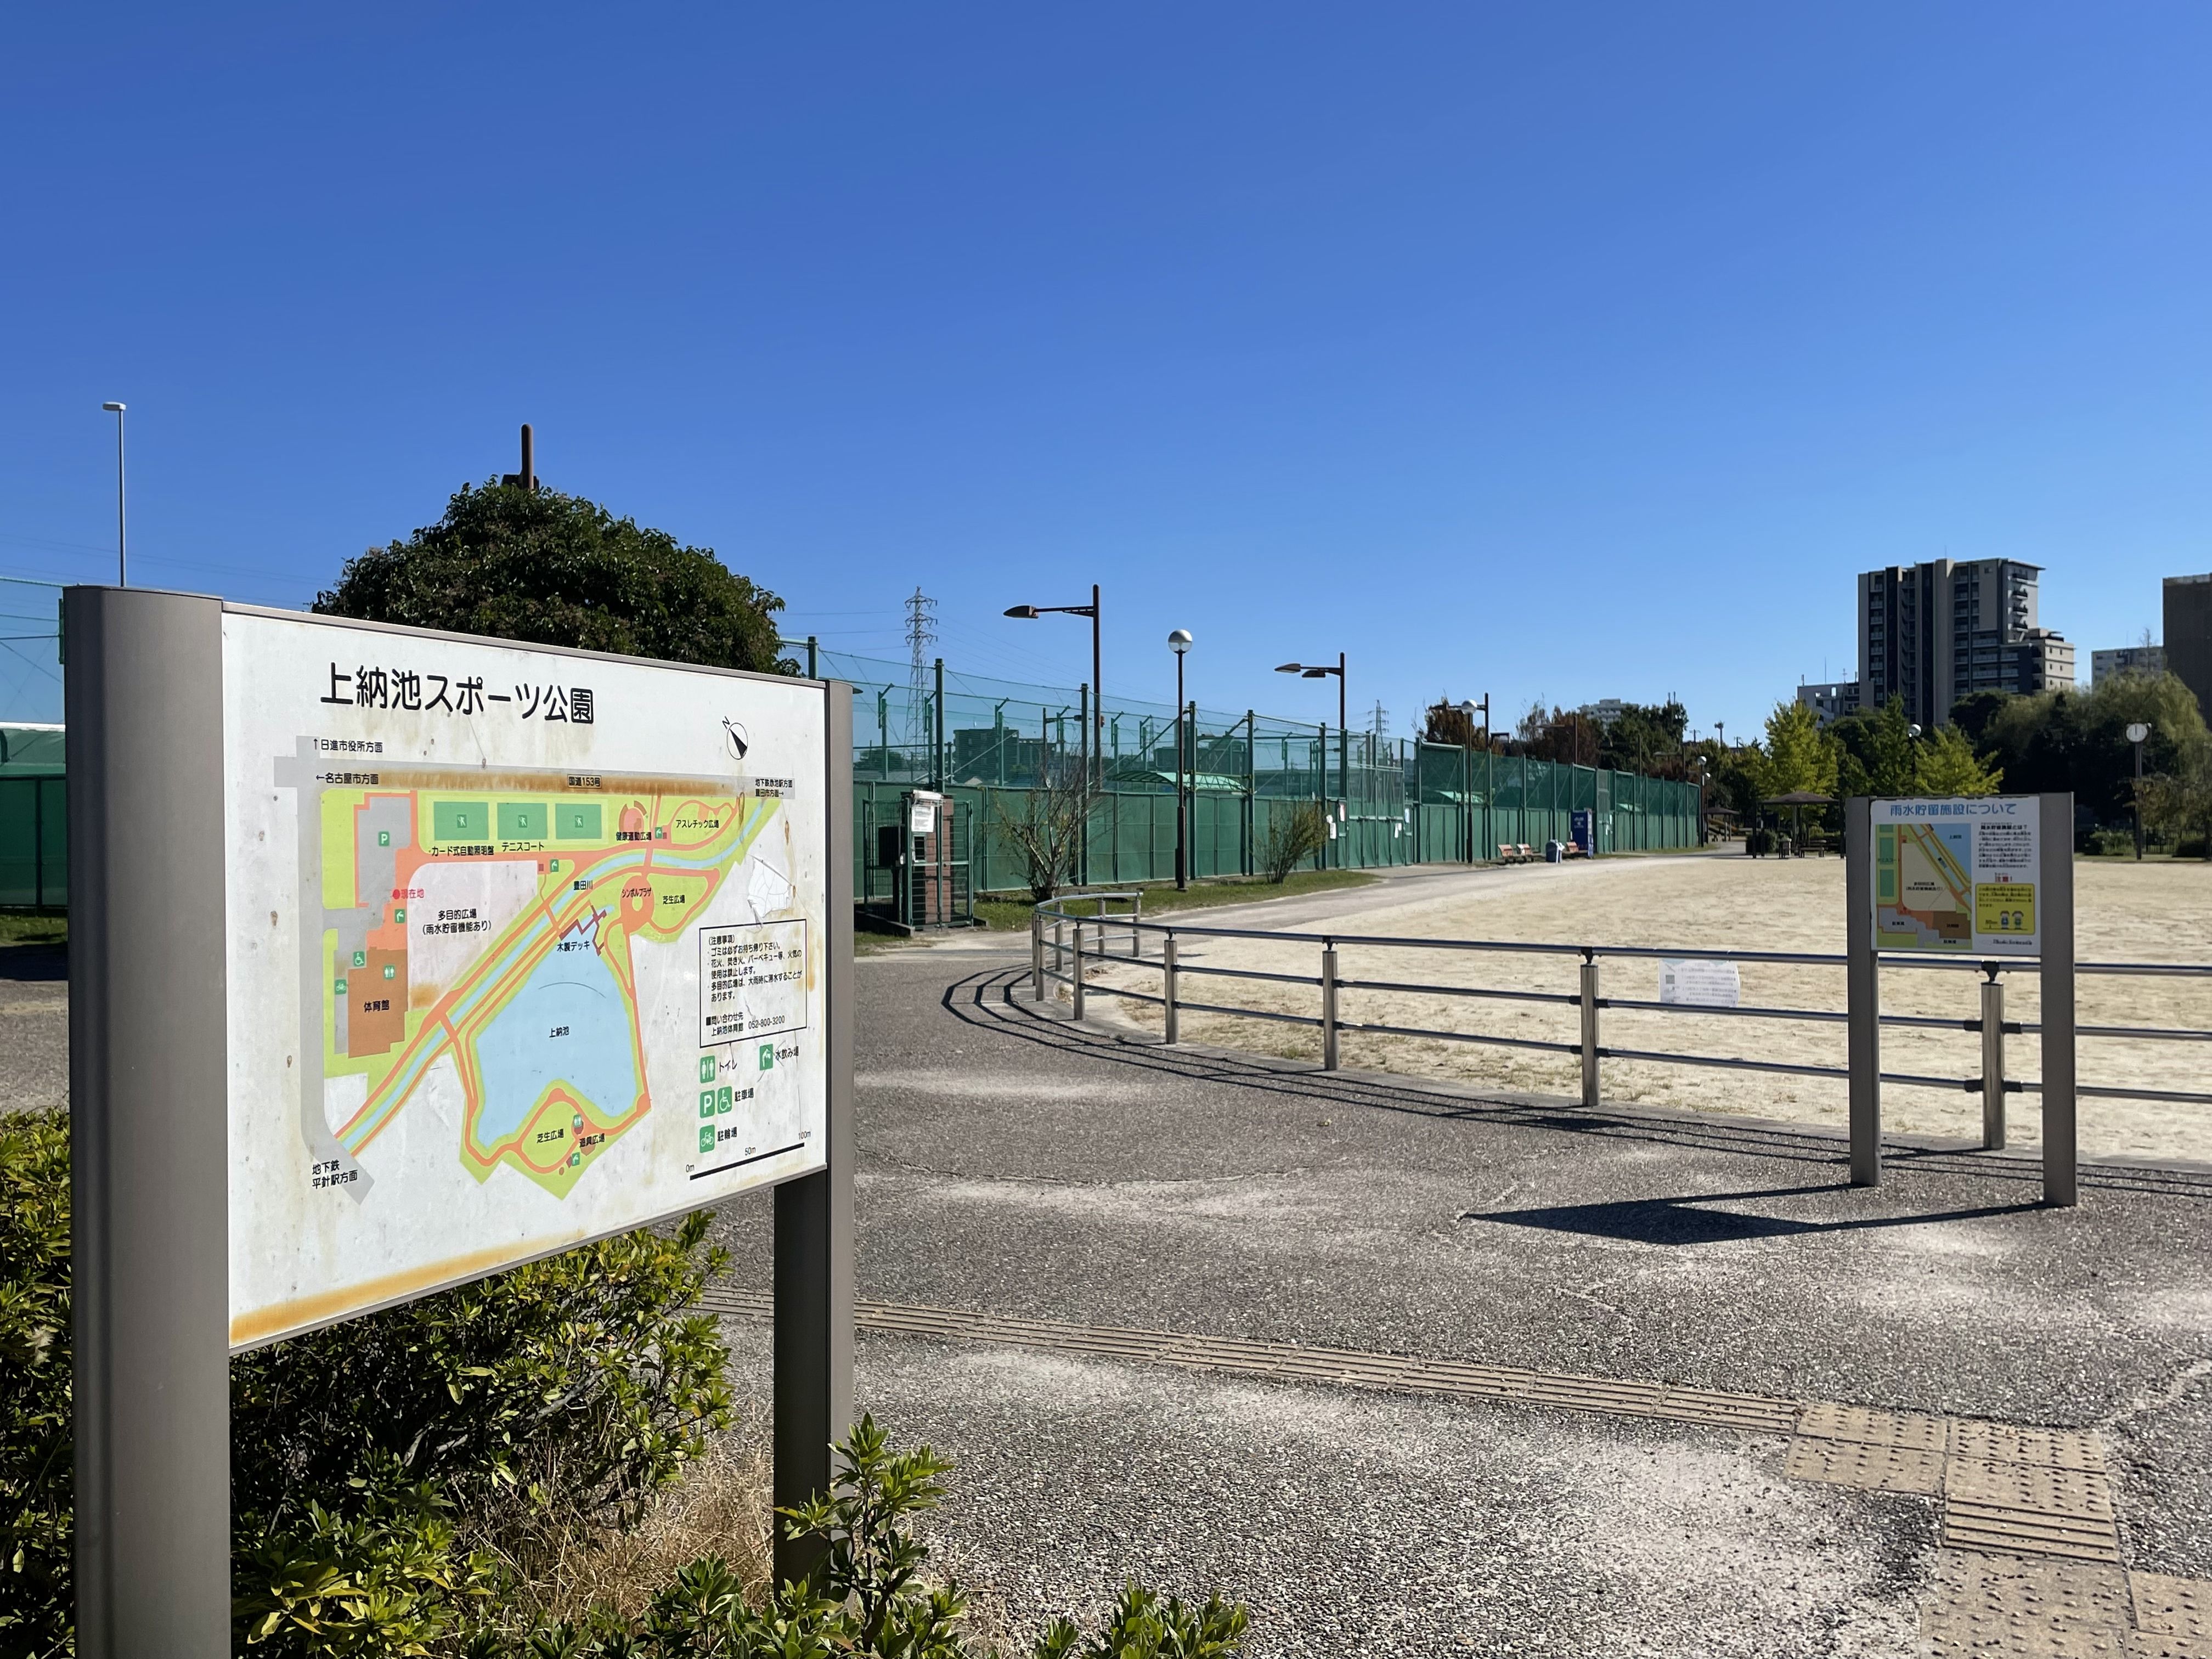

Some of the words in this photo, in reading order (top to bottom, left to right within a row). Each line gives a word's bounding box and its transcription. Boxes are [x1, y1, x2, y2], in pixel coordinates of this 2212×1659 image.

[320, 662, 594, 724] 上納池スポーツ公園
[722, 716, 730, 729] N
[321, 739, 383, 753] 日進市役所方面
[325, 772, 379, 785] 名古屋市方面
[569, 776, 601, 787] 国道153号
[1891, 803, 2017, 816] 雨水貯留施設について
[675, 820, 719, 828] アスレチック広場
[501, 842, 544, 852] テニスコート
[574, 880, 592, 890] 豊田川
[401, 889, 424, 899] 現在地
[622, 887, 652, 898] シンボルプラザ
[662, 895, 685, 905] 芝生広場
[438, 909, 476, 921] 多目的広場
[557, 940, 590, 952] 木製デッキ
[711, 966, 755, 980] 使用は禁止します。
[711, 991, 735, 1002] あります。
[364, 1000, 390, 1013] 体育館
[549, 1026, 569, 1038] 上納池
[711, 1023, 743, 1036] 上納池体育館
[748, 1015, 785, 1029] 052-800-3200
[775, 1046, 799, 1060] 水飲み場
[719, 1060, 737, 1073] トイレ
[735, 1088, 754, 1102] 駐車場
[537, 1128, 564, 1143] 芝生広場
[579, 1133, 605, 1148] 遊具広場
[717, 1127, 737, 1142] 駐輪場
[798, 1131, 811, 1140] 100m
[744, 1147, 756, 1155] 50m
[312, 1159, 340, 1175] 地下鉄
[686, 1164, 695, 1172] 0m
[312, 1170, 358, 1189] 平針駅方面
